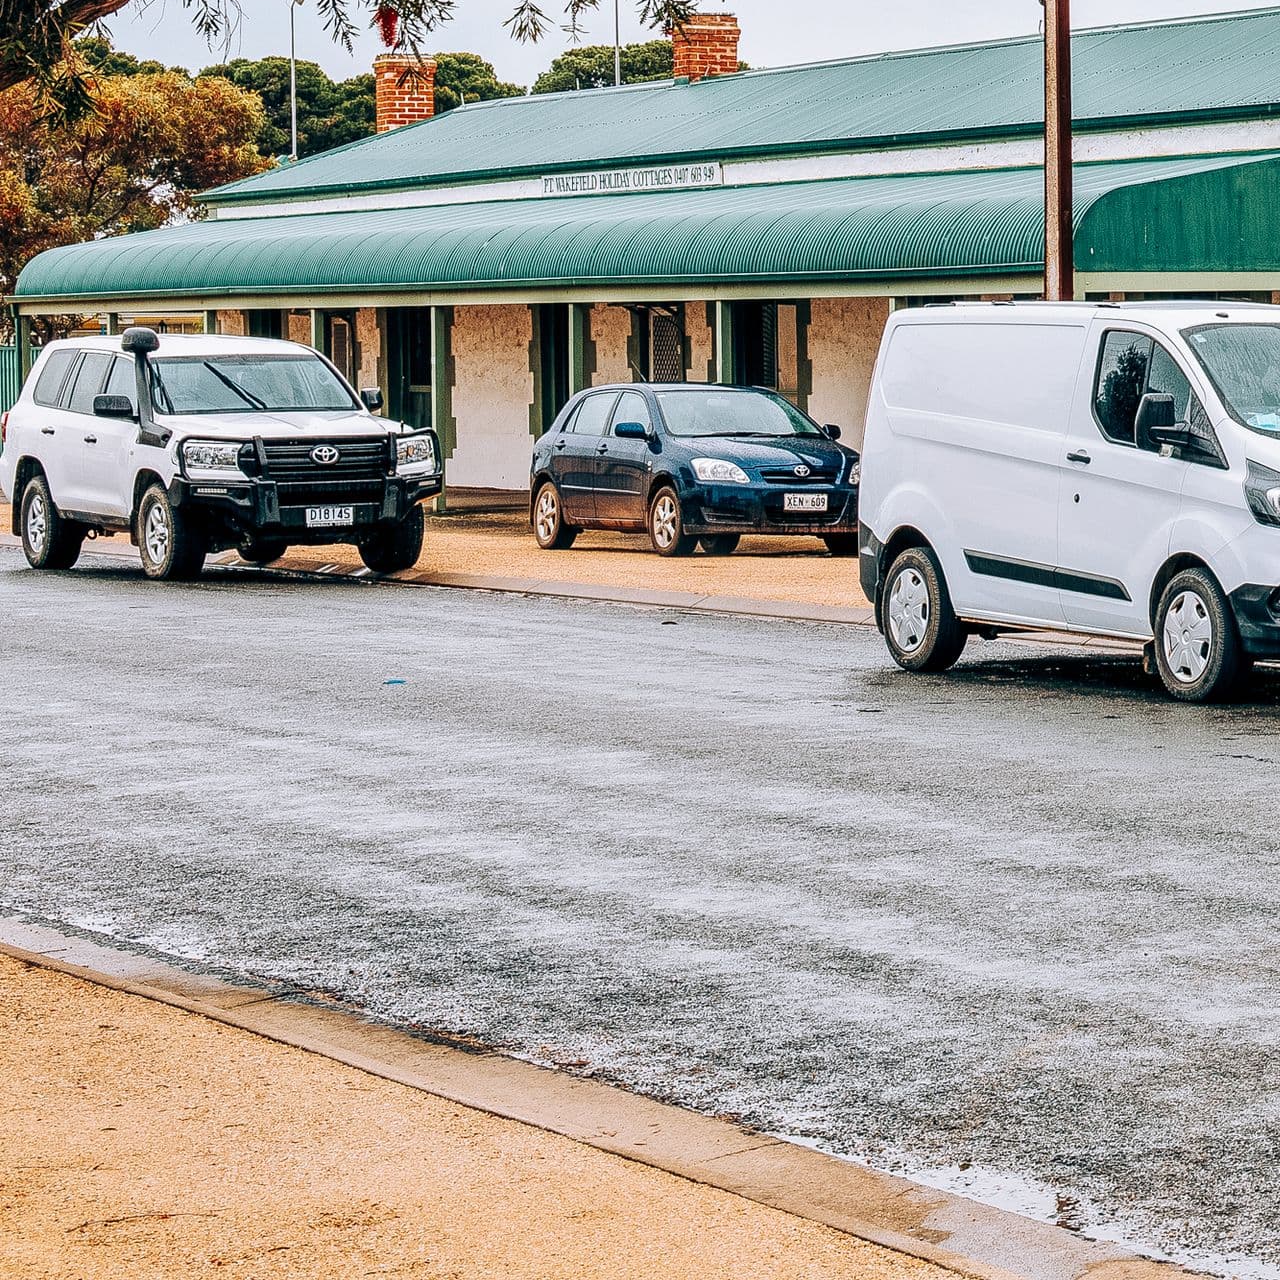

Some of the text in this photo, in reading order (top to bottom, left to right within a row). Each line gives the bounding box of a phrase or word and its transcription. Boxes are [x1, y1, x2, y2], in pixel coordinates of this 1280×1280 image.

[556, 175, 597, 192] WAKEFIELD
[599, 172, 630, 190] HOLIDAY
[633, 169, 672, 187] COTTAGES
